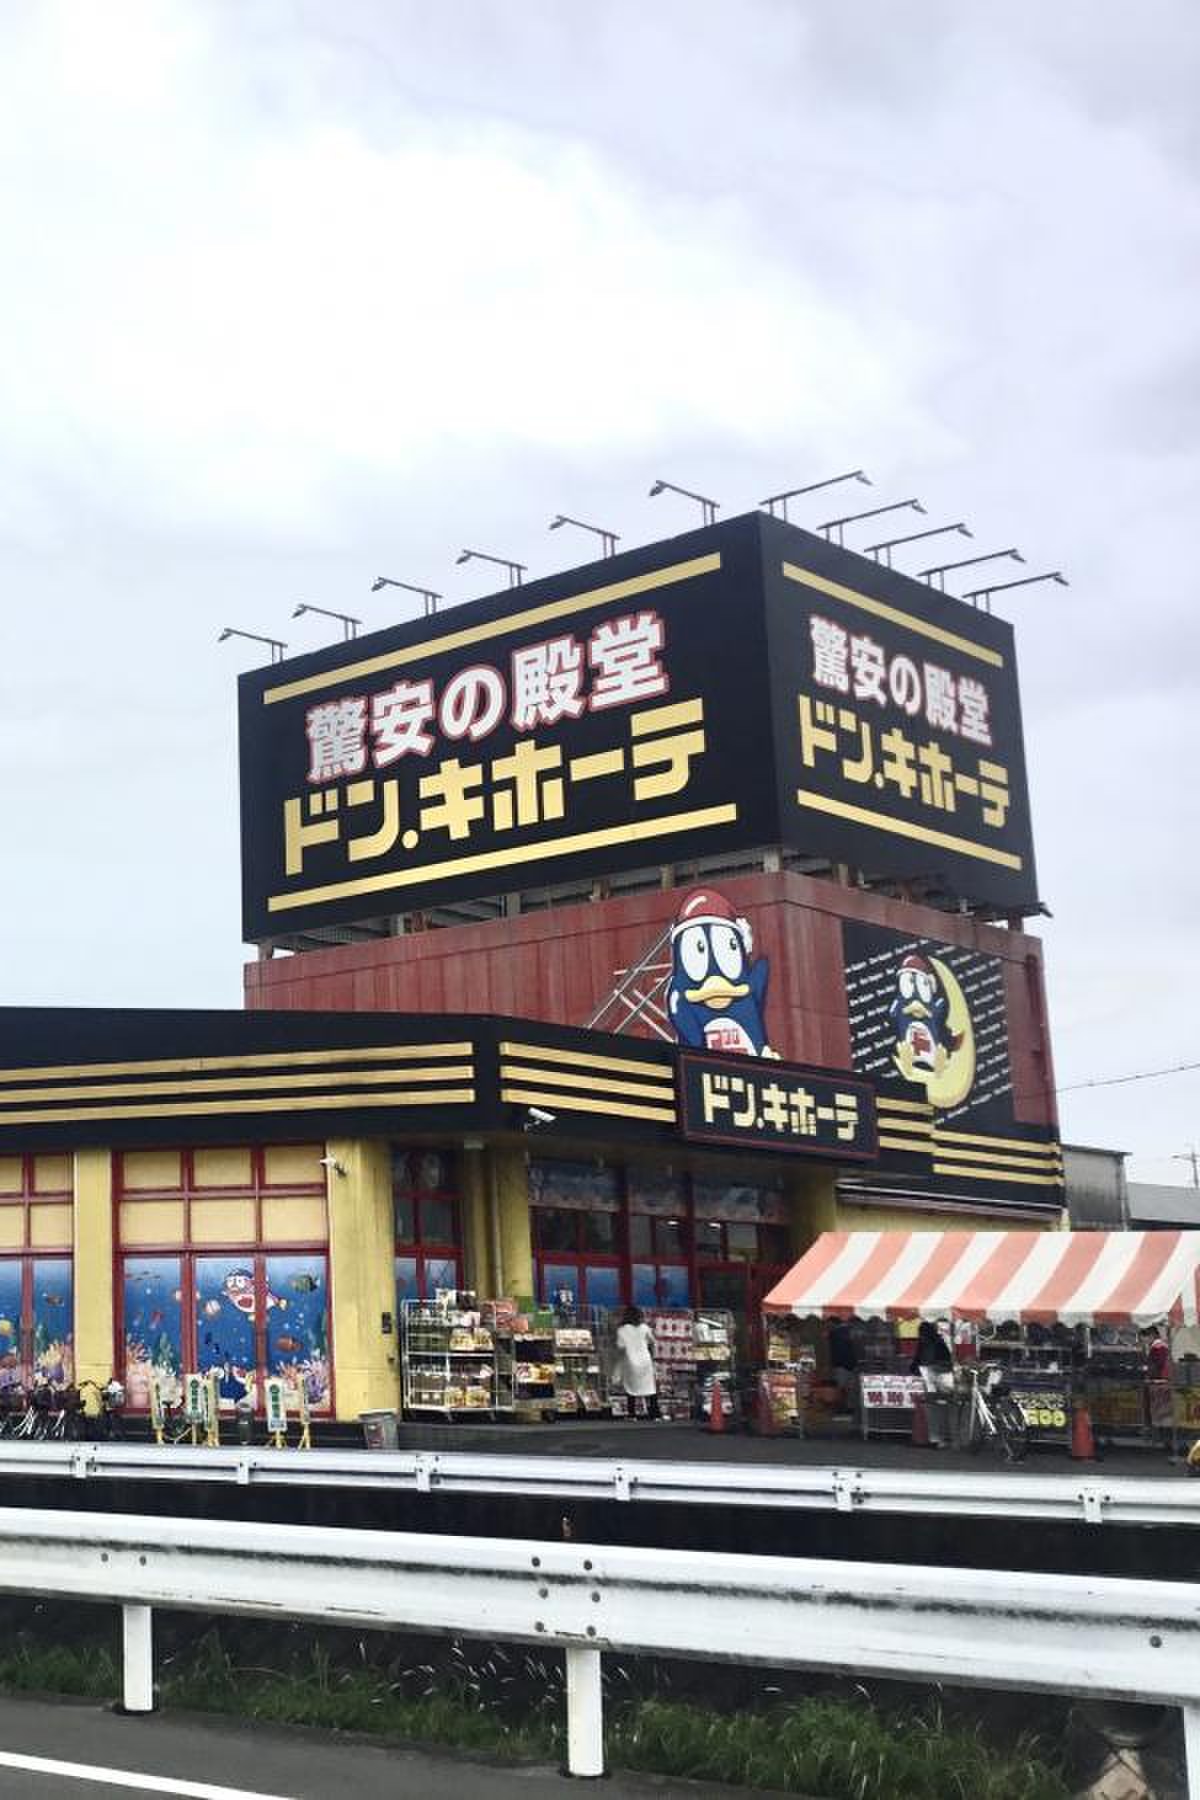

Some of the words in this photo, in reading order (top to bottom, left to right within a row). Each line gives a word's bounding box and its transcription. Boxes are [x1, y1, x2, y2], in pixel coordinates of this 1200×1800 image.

[305, 609, 670, 783] 驚安の殿堂
[809, 614, 993, 747] 驚安の殿堂
